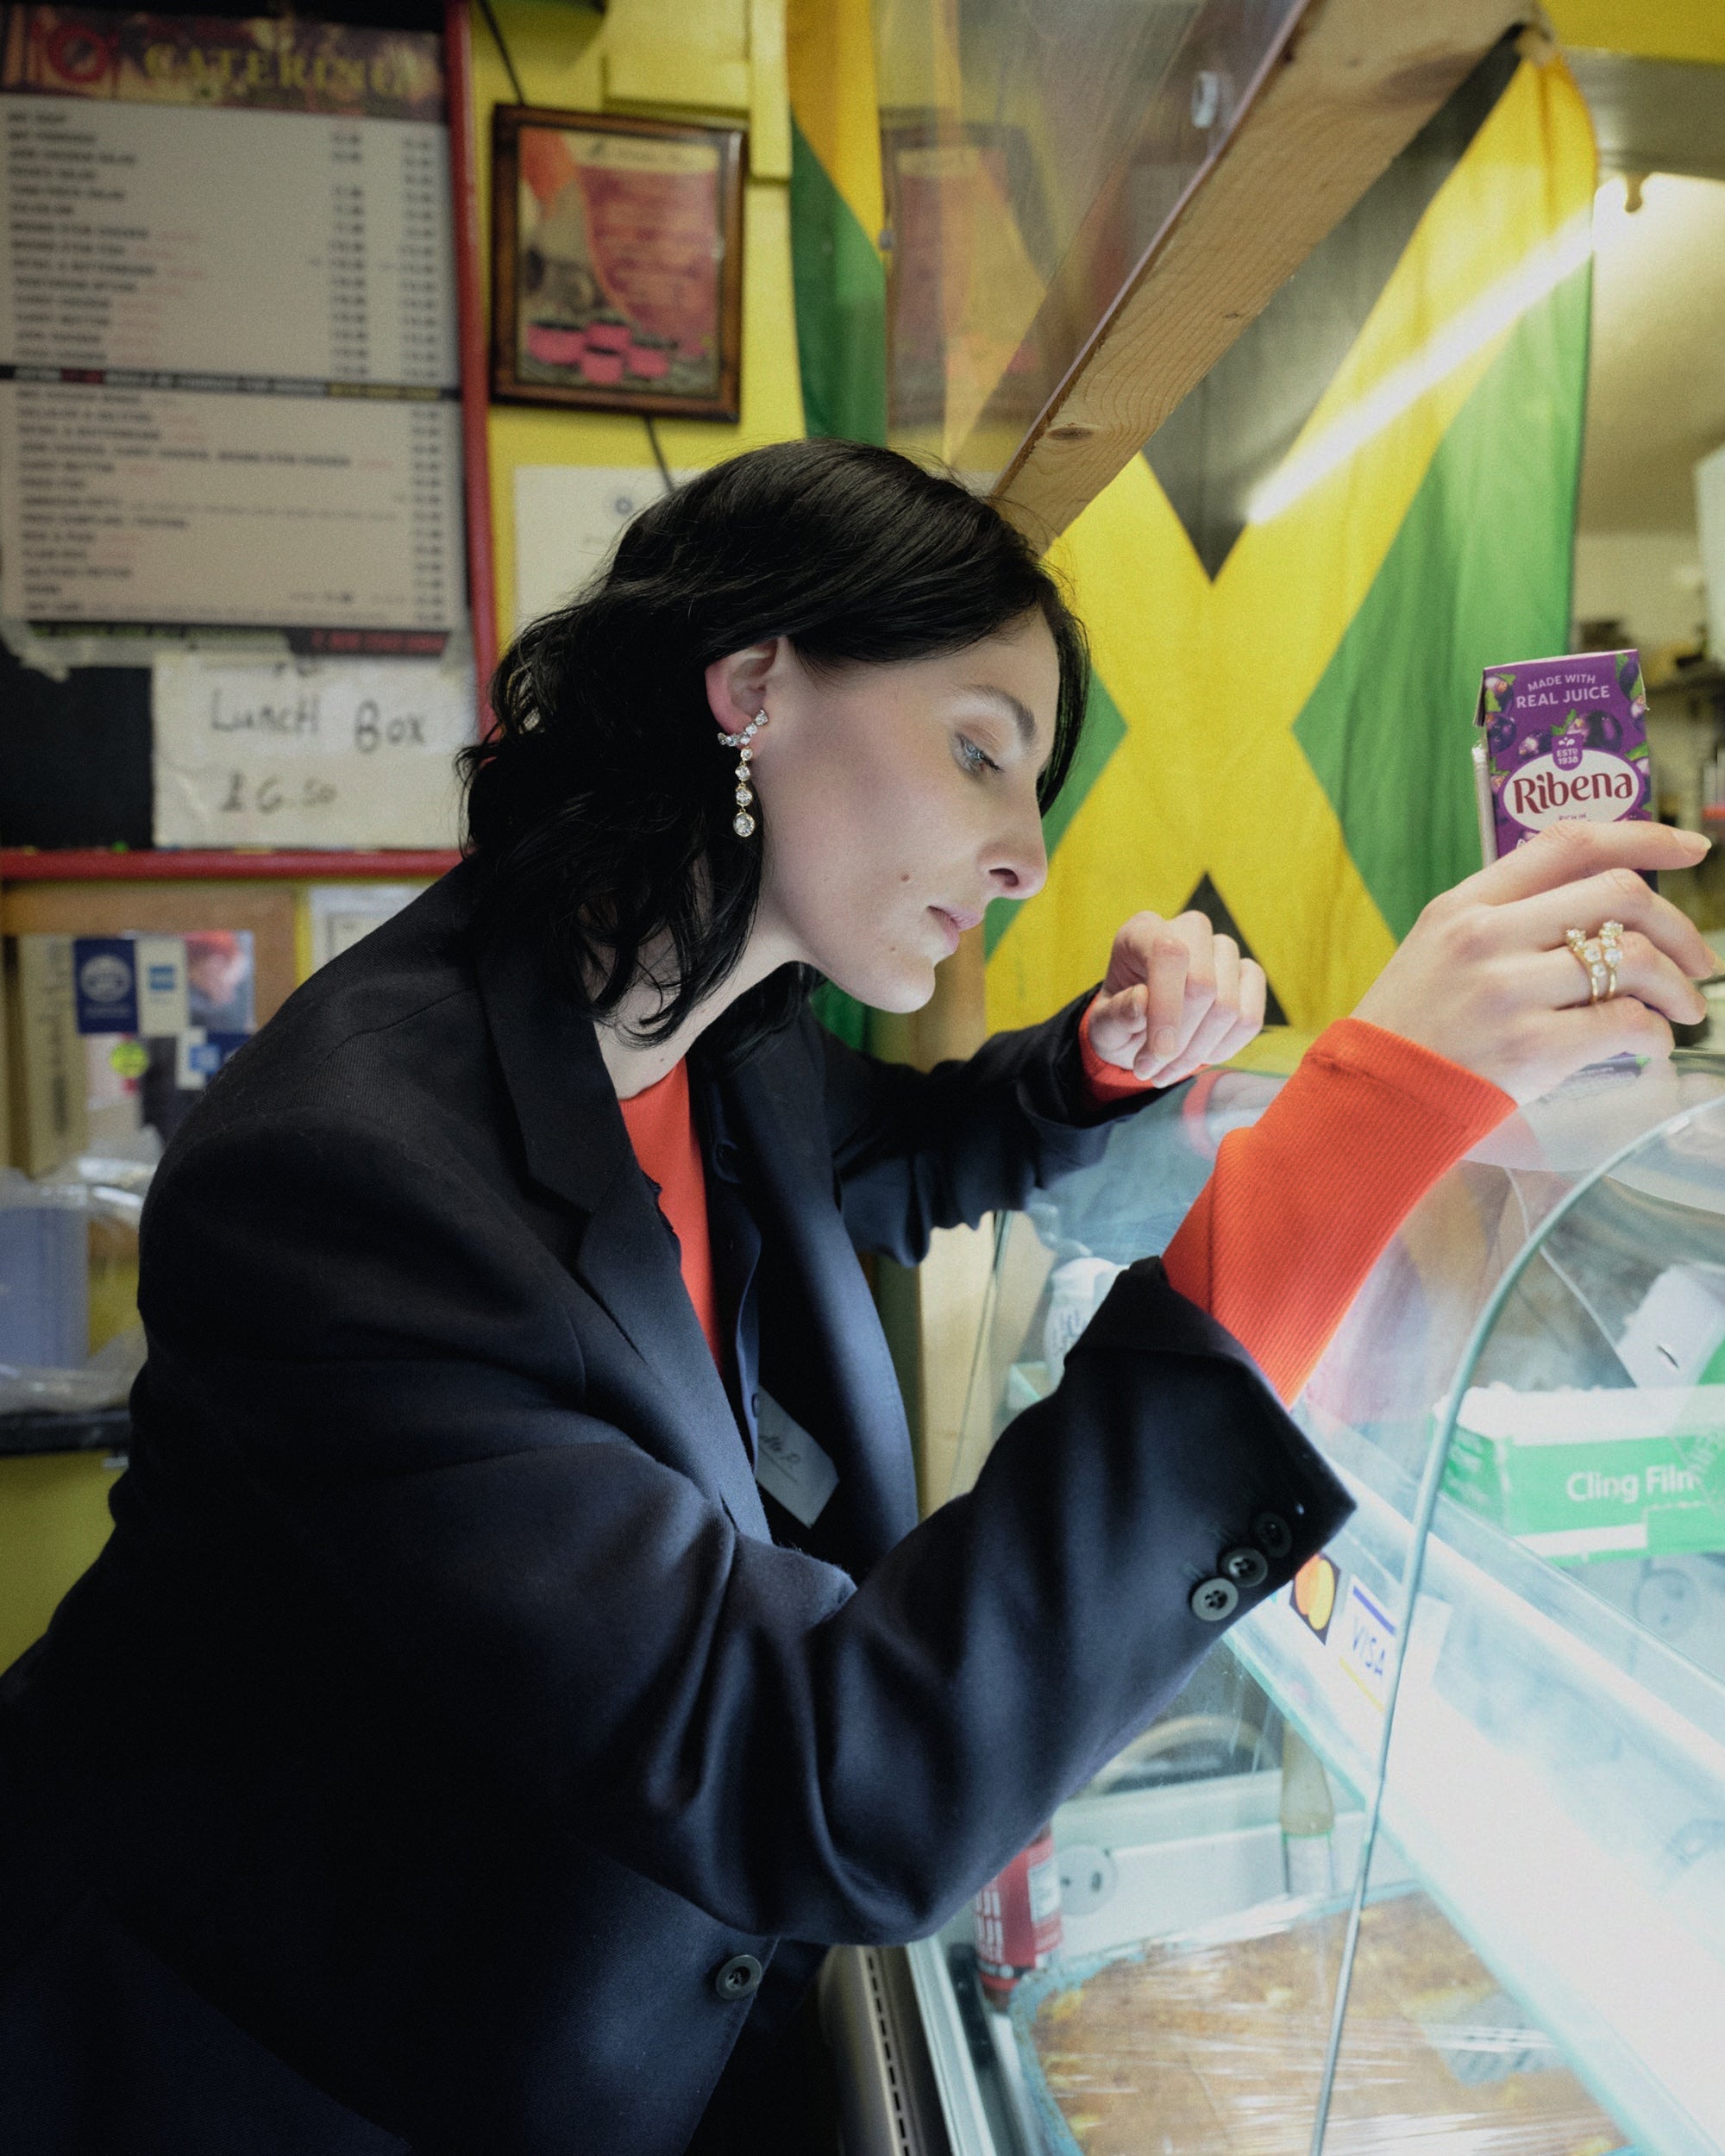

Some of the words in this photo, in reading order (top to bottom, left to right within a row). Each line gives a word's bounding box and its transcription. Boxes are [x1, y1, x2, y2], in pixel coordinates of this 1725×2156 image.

[143, 43, 414, 97] CATERING
[1515, 692, 1559, 708] REAL
[1562, 686, 1610, 703] JUICE
[1527, 675, 1562, 691] MADE
[1565, 674, 1596, 684] WITH
[1558, 756, 1578, 765] 1938
[1513, 771, 1634, 814] Ribena
[1566, 1470, 1639, 1504] Cling
[1352, 1614, 1386, 1677] VISA
